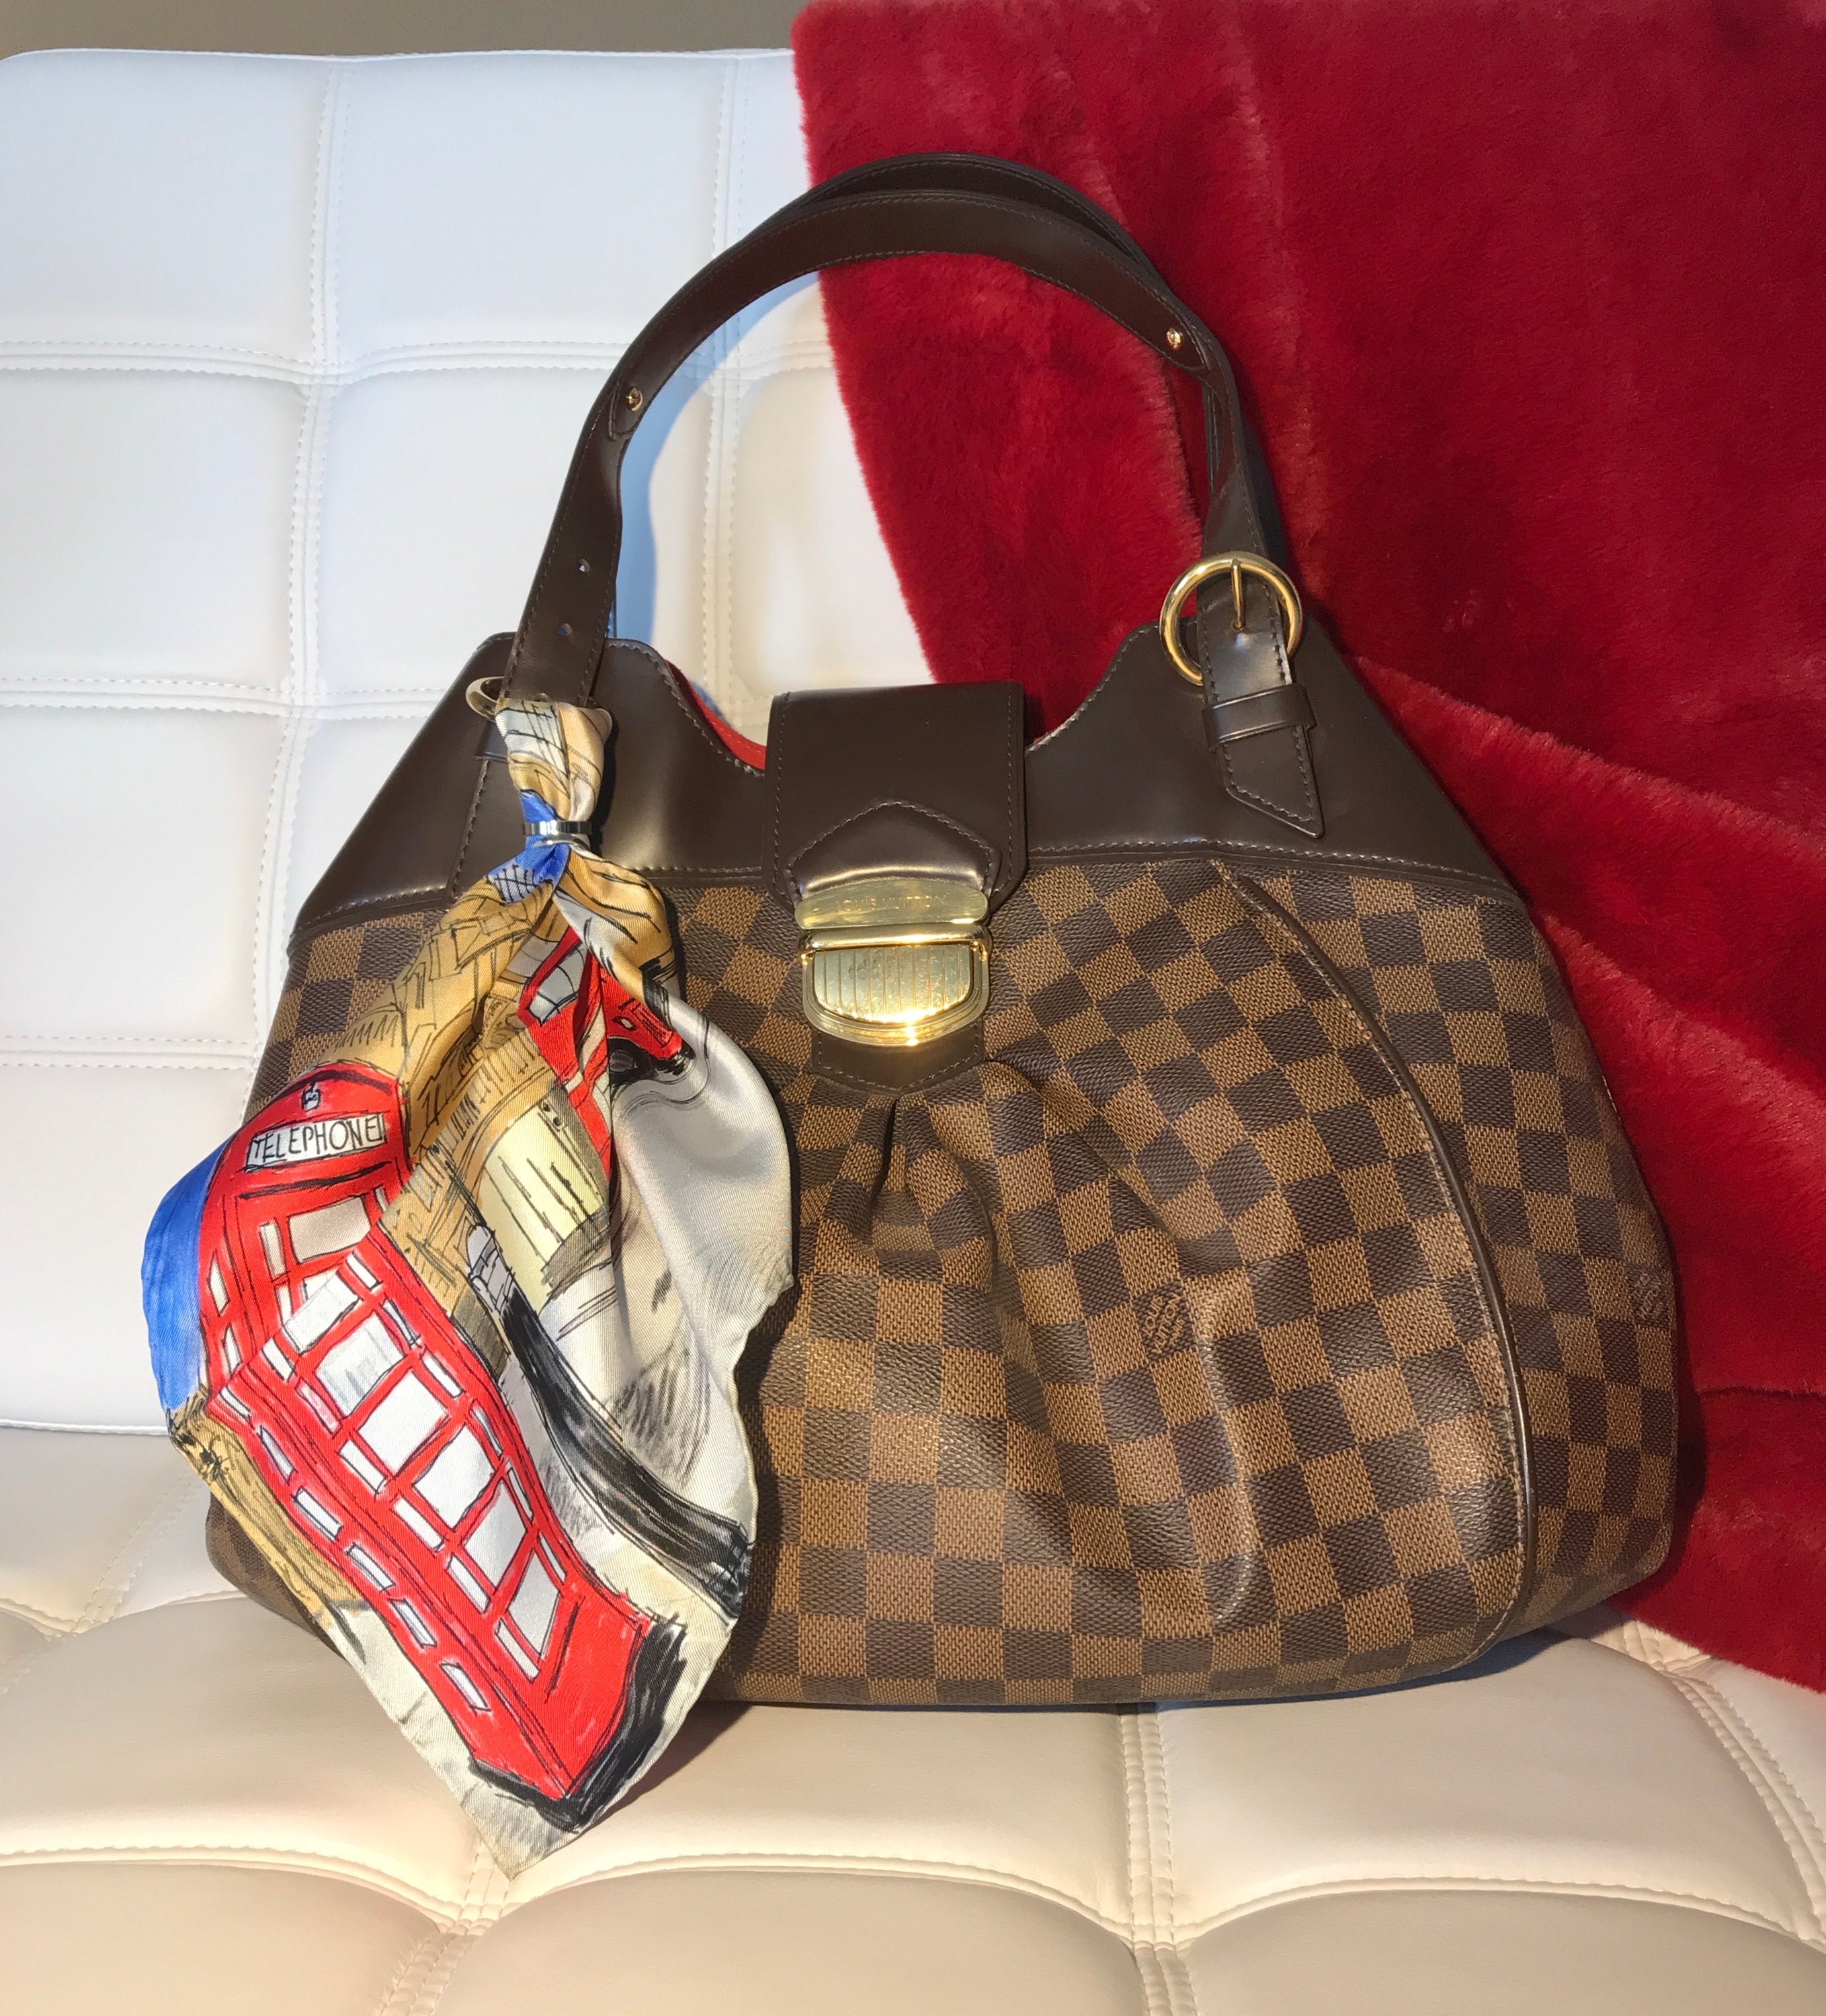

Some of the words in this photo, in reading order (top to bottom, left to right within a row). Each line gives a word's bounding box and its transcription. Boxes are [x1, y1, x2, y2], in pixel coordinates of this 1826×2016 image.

[252, 1114, 382, 1161] TELEPHONE
[1143, 1294, 1163, 1337] LOUIS
[1151, 1292, 1181, 1353] VUITTON
